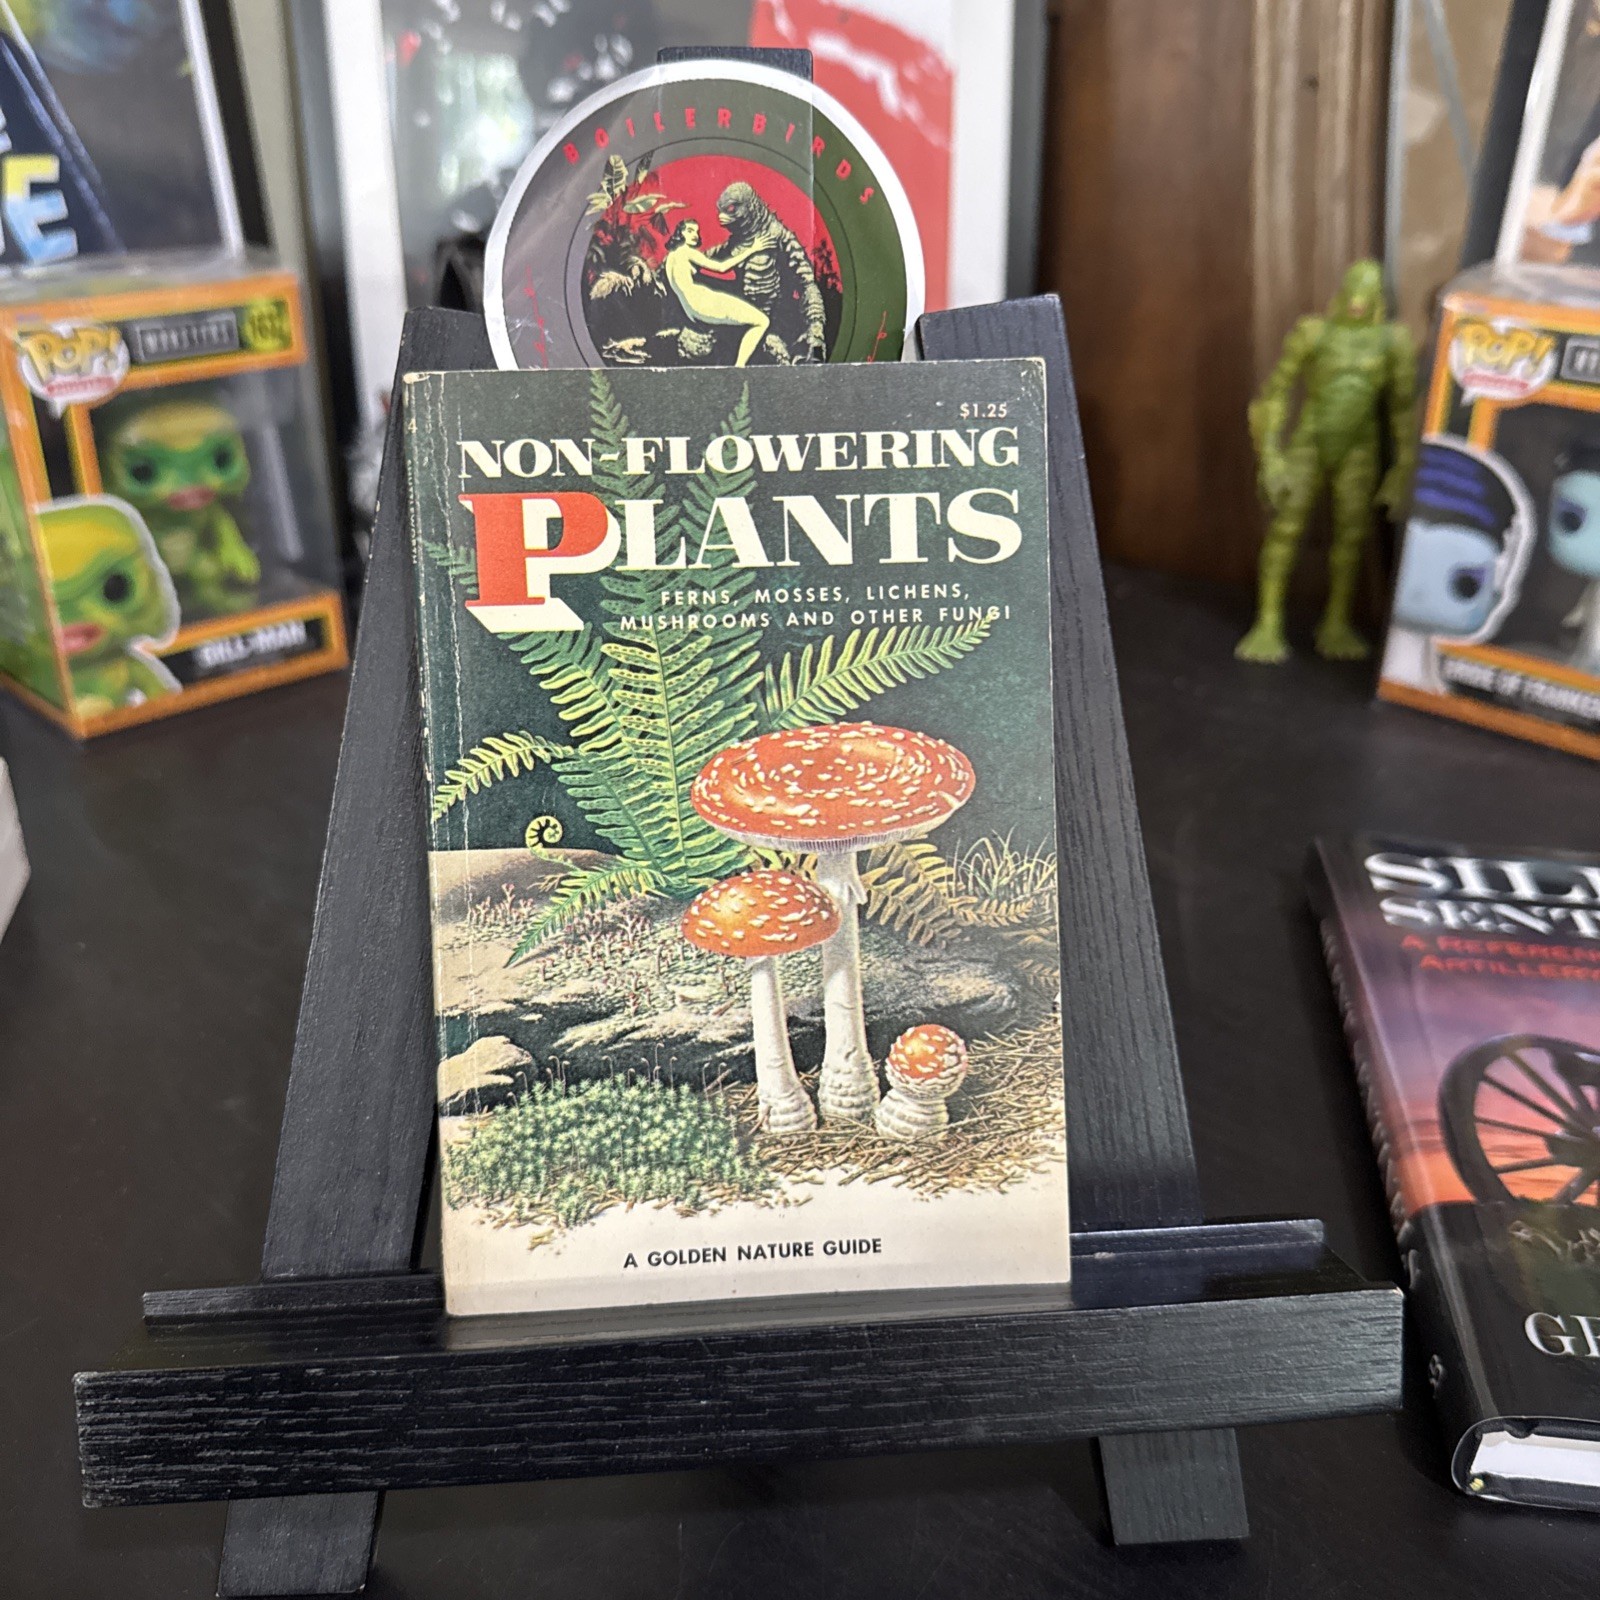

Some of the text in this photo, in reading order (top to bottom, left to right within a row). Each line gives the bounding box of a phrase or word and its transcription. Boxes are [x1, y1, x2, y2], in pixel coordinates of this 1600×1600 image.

[960, 402, 1008, 420] $1.25
[456, 427, 1020, 478] NON-FLOWERING
[458, 487, 1022, 634] PLANTS
[661, 583, 970, 607] FERNS, MOSSES, LICHENS,
[620, 605, 1011, 631] MUSHROOMS AND OTHER FUNGI
[623, 1238, 882, 1269] A GOLDEN NATURE GUIDE
